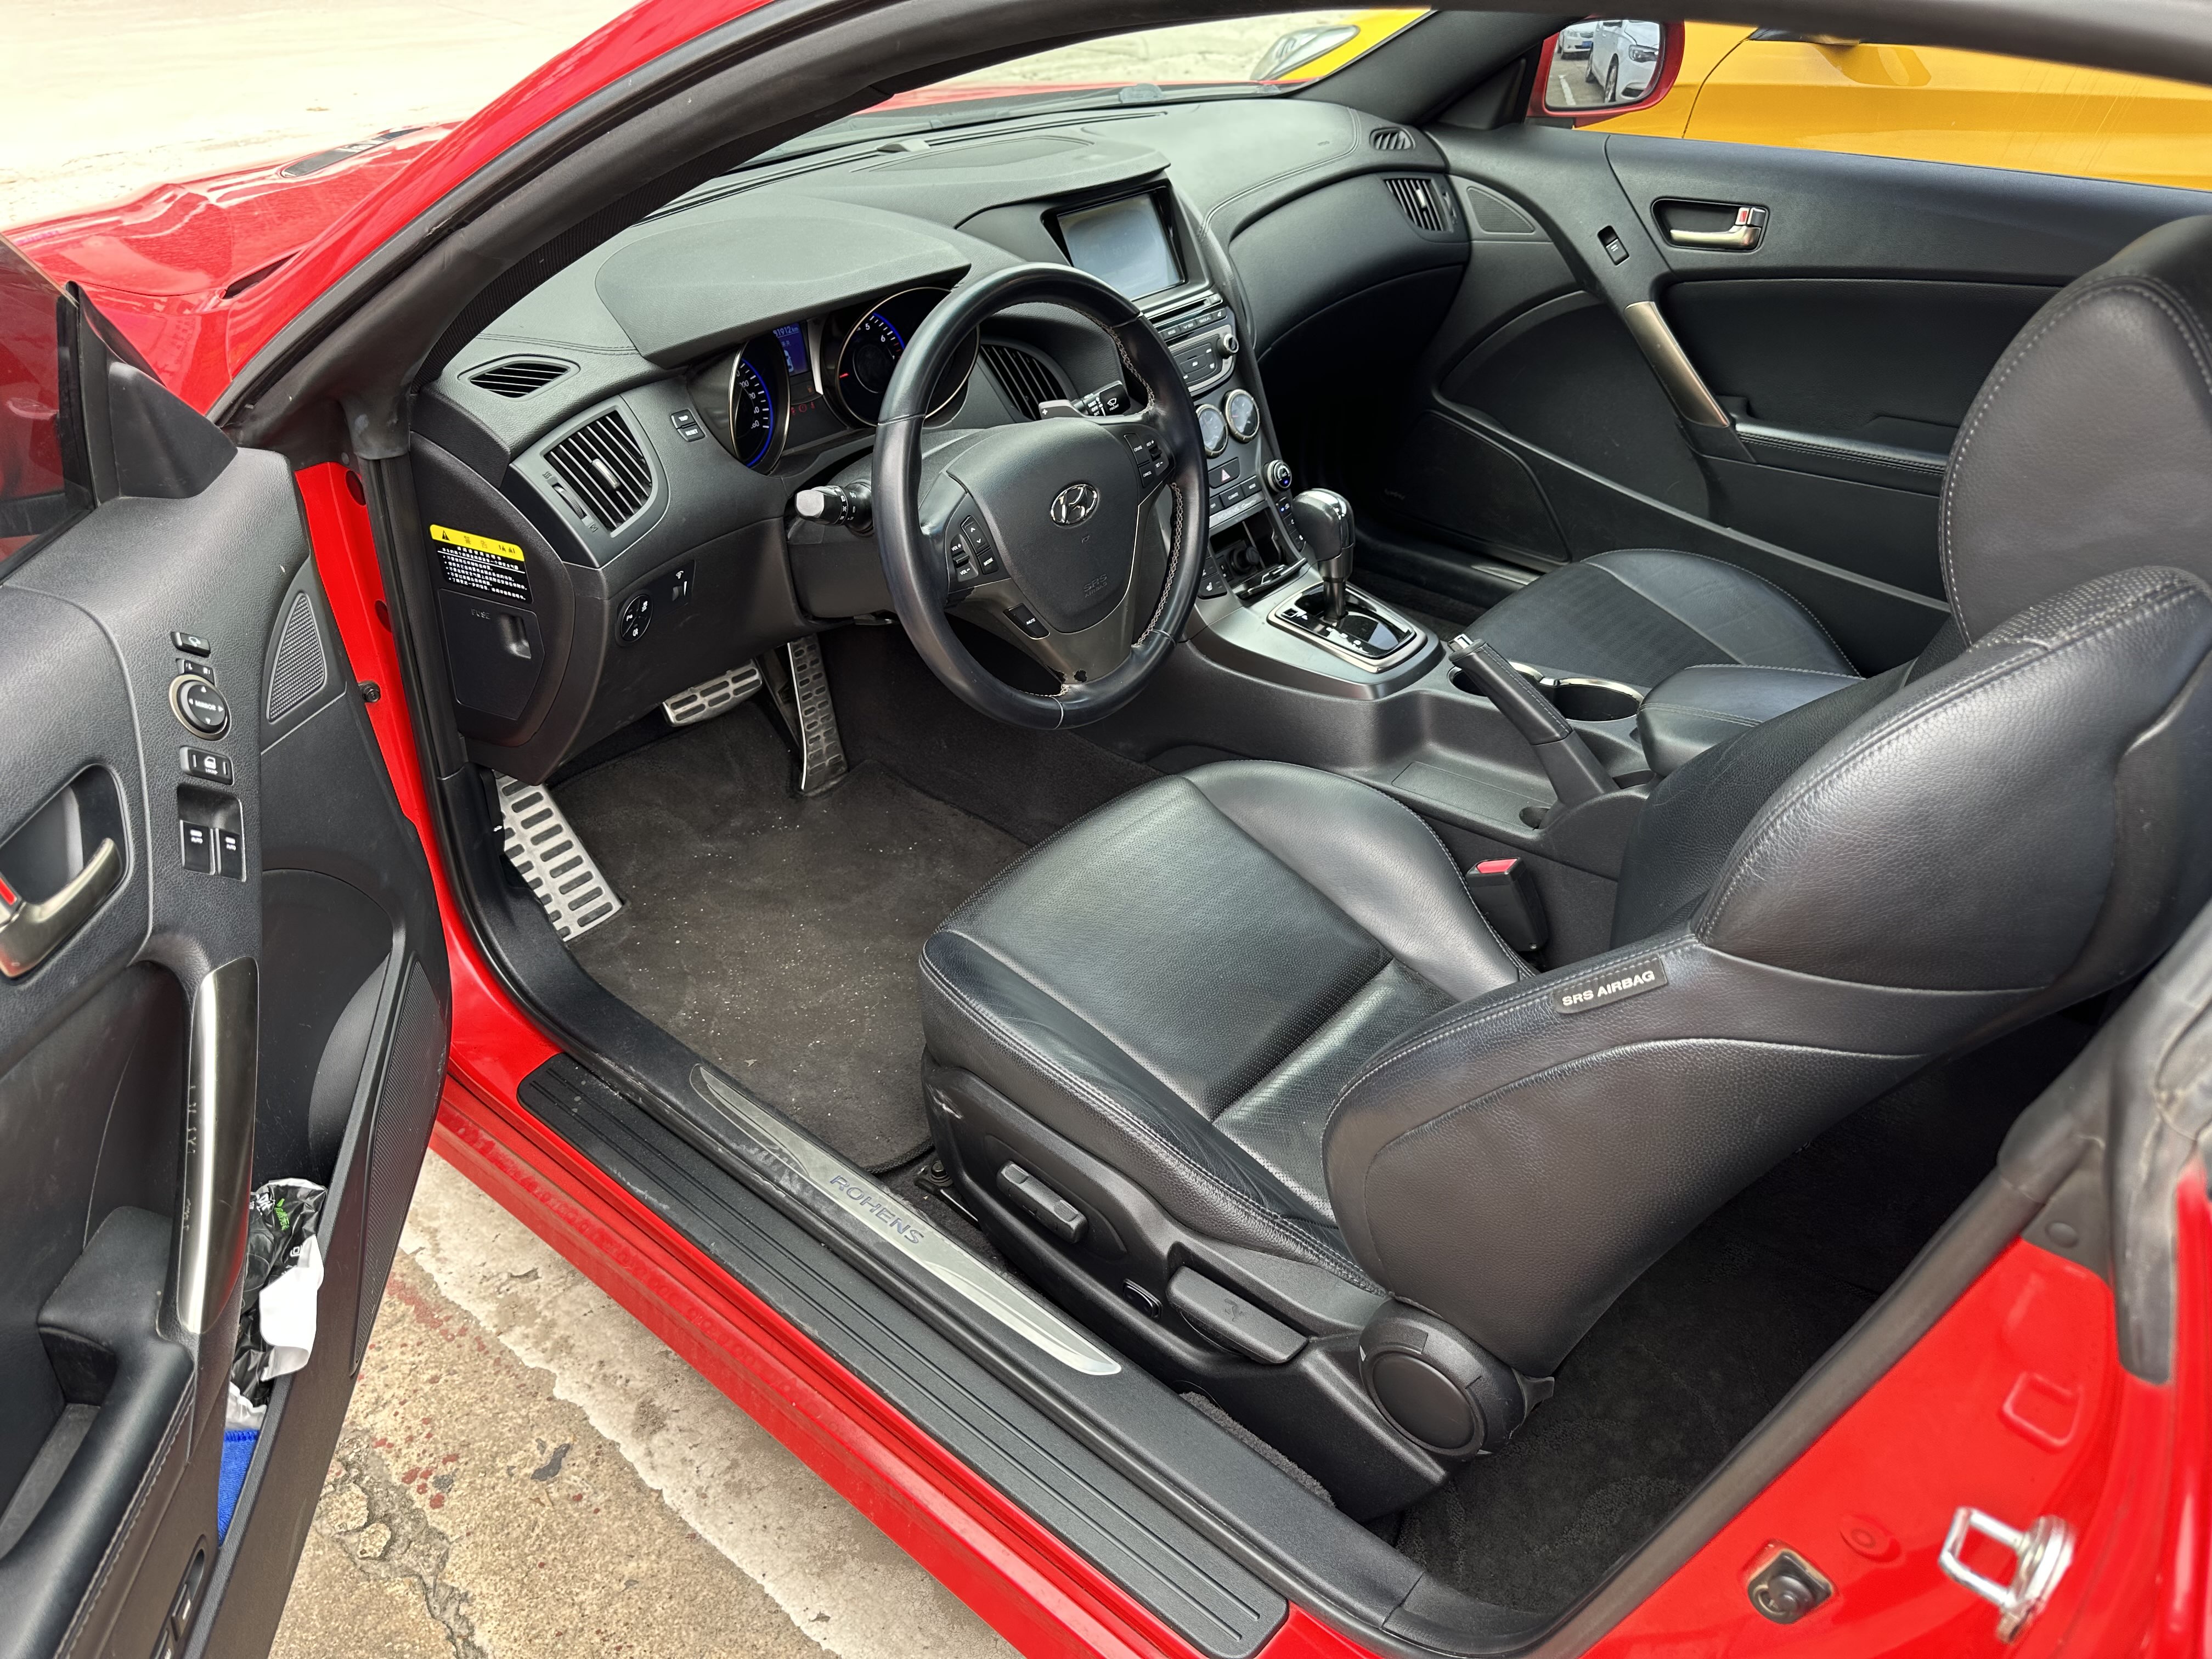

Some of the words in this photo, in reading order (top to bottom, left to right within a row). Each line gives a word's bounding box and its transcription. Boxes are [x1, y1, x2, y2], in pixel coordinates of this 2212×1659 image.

[471, 608, 492, 620] FUSE
[195, 699, 217, 711] MIRROR
[191, 836, 204, 844] AUTO
[1562, 990, 1594, 1006] SRS
[1597, 970, 1655, 997] AIRBAG
[830, 1175, 924, 1244] ROHENS
